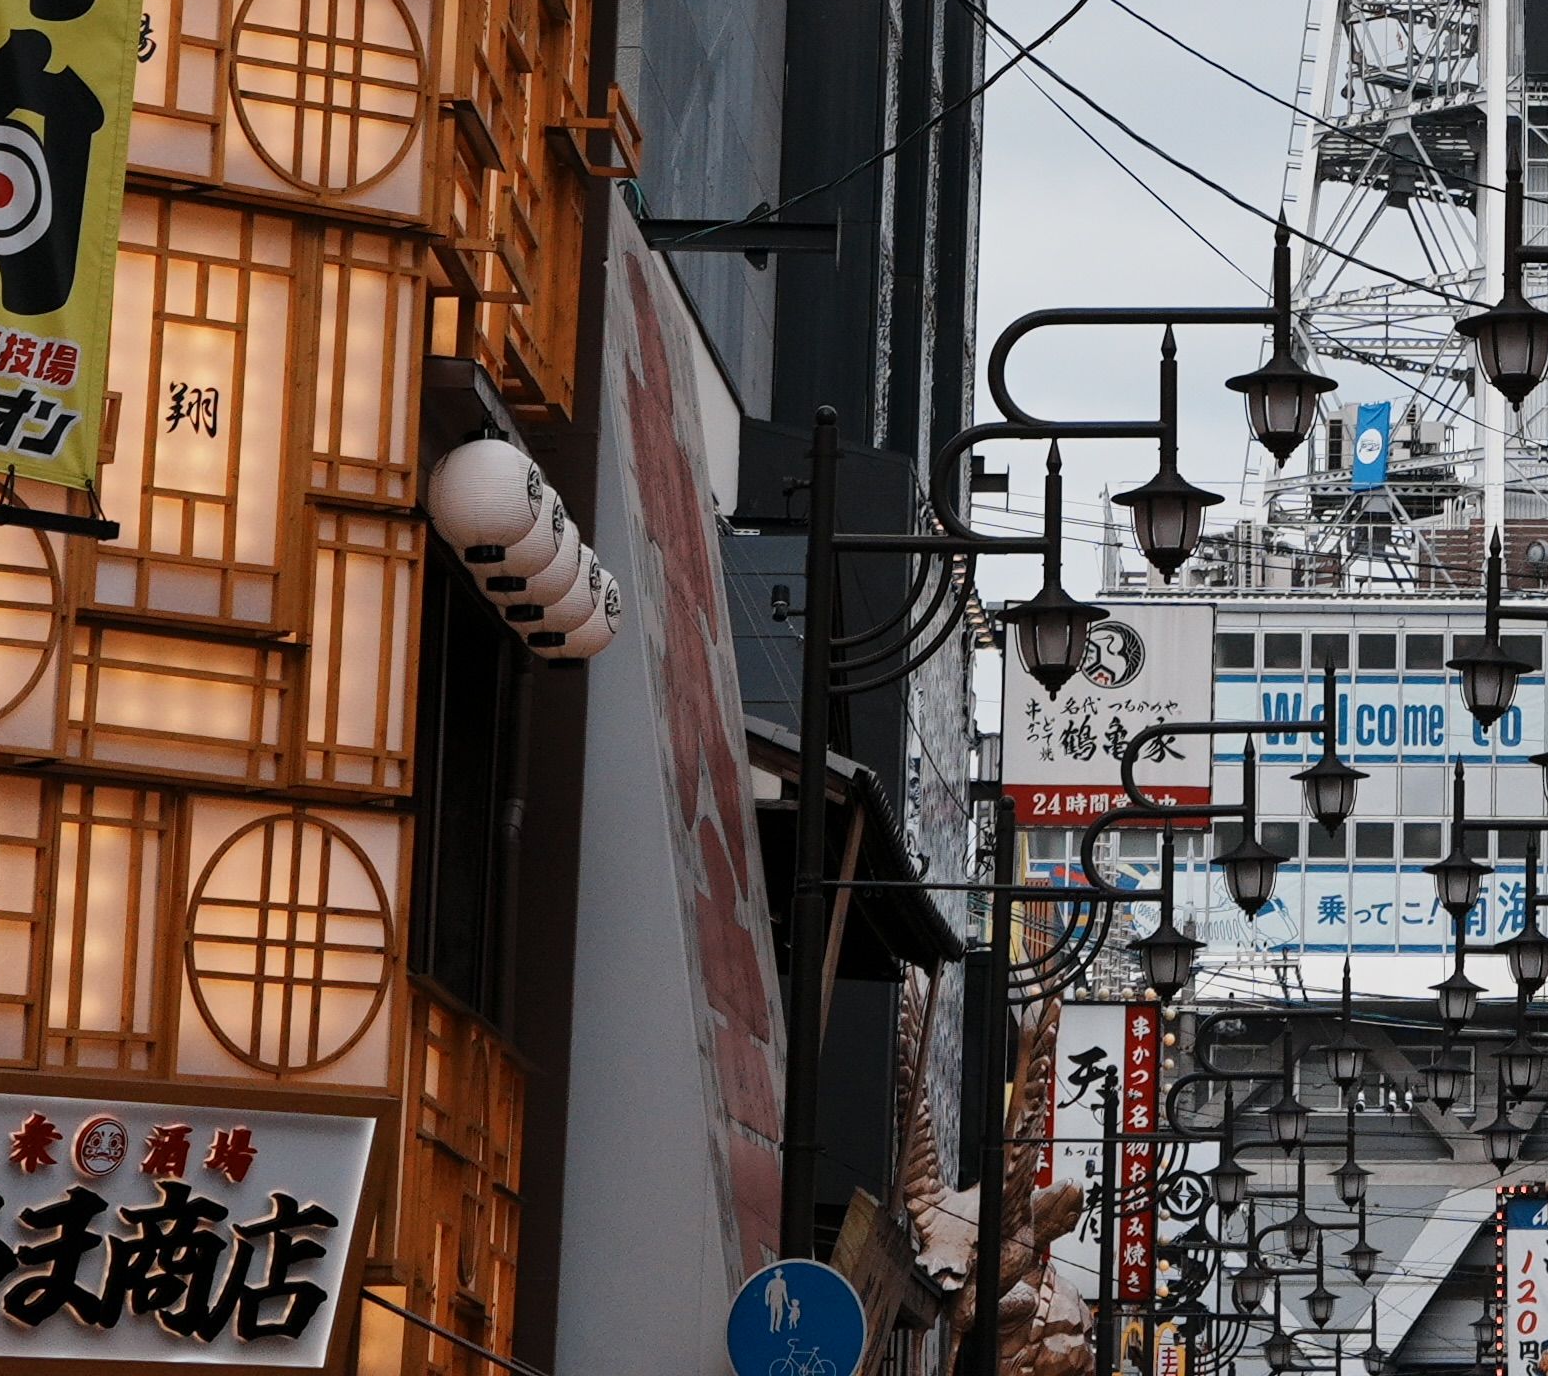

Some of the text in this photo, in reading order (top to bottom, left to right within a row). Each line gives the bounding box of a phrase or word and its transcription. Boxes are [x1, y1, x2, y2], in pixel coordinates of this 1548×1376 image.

[1262, 692, 1444, 747] Welcome
[1033, 792, 1177, 816] 24時間営中
[1127, 1015, 1151, 1086] 串かつ
